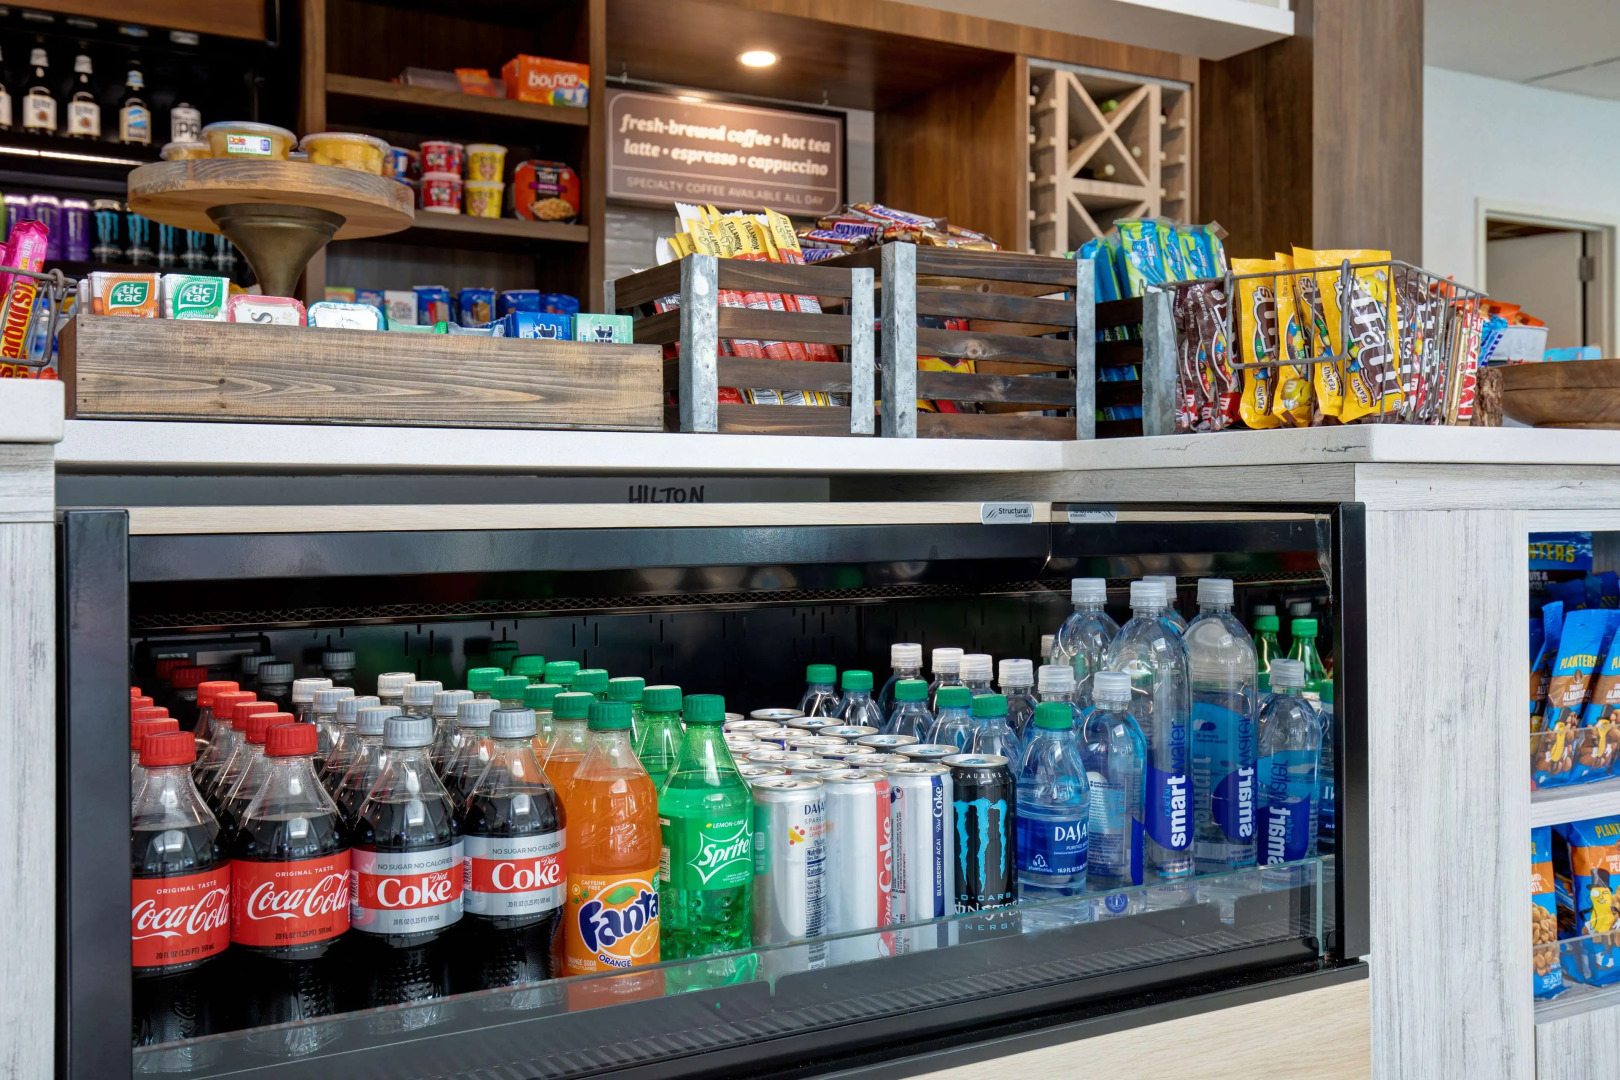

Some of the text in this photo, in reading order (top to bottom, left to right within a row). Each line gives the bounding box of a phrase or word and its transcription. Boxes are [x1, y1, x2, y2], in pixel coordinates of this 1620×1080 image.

[528, 70, 578, 90] bounce
[229, 136, 246, 145] Dole
[619, 114, 831, 154] fresh-brewed coffee hot tea
[624, 139, 828, 176] latte espresso cappuccino
[627, 176, 824, 206] SPECIALTY COFFEE AVAILABLE ALL DAY
[725, 221, 743, 252] TILLAMOOK
[742, 221, 760, 250] TILLAMOOK
[117, 293, 141, 303] tac
[123, 284, 143, 294] tic
[193, 285, 212, 295] tic
[186, 294, 210, 303] tac
[1321, 365, 1336, 391] PEANUT
[1257, 385, 1265, 409] PEANUT
[1352, 378, 1369, 404] PEANUT
[628, 485, 705, 503] HILTON
[998, 507, 1029, 515] Structural
[1560, 654, 1598, 670] PLANTERS
[933, 786, 943, 818] Coke
[712, 819, 745, 829] LEMON-LIME
[538, 841, 561, 852] CALORIES
[698, 838, 750, 868] Sprite
[879, 816, 891, 893] Coke
[426, 857, 453, 868] CALORIES
[541, 856, 557, 866] Diet
[275, 864, 334, 878] ORIGINAL TASTE
[429, 872, 448, 883] Diet
[491, 860, 560, 890] Coke
[156, 880, 217, 895] ORIGINAL TASTE
[247, 870, 351, 920] Coca-Cola
[377, 876, 453, 908] Coke
[132, 885, 230, 940] Coca-Cola
[578, 889, 659, 954] Fanta
[275, 932, 283, 940] 20
[289, 931, 295, 939] OZ
[156, 952, 163, 960] 20
[171, 950, 178, 958] OZ
[598, 954, 632, 968] ORANGE
